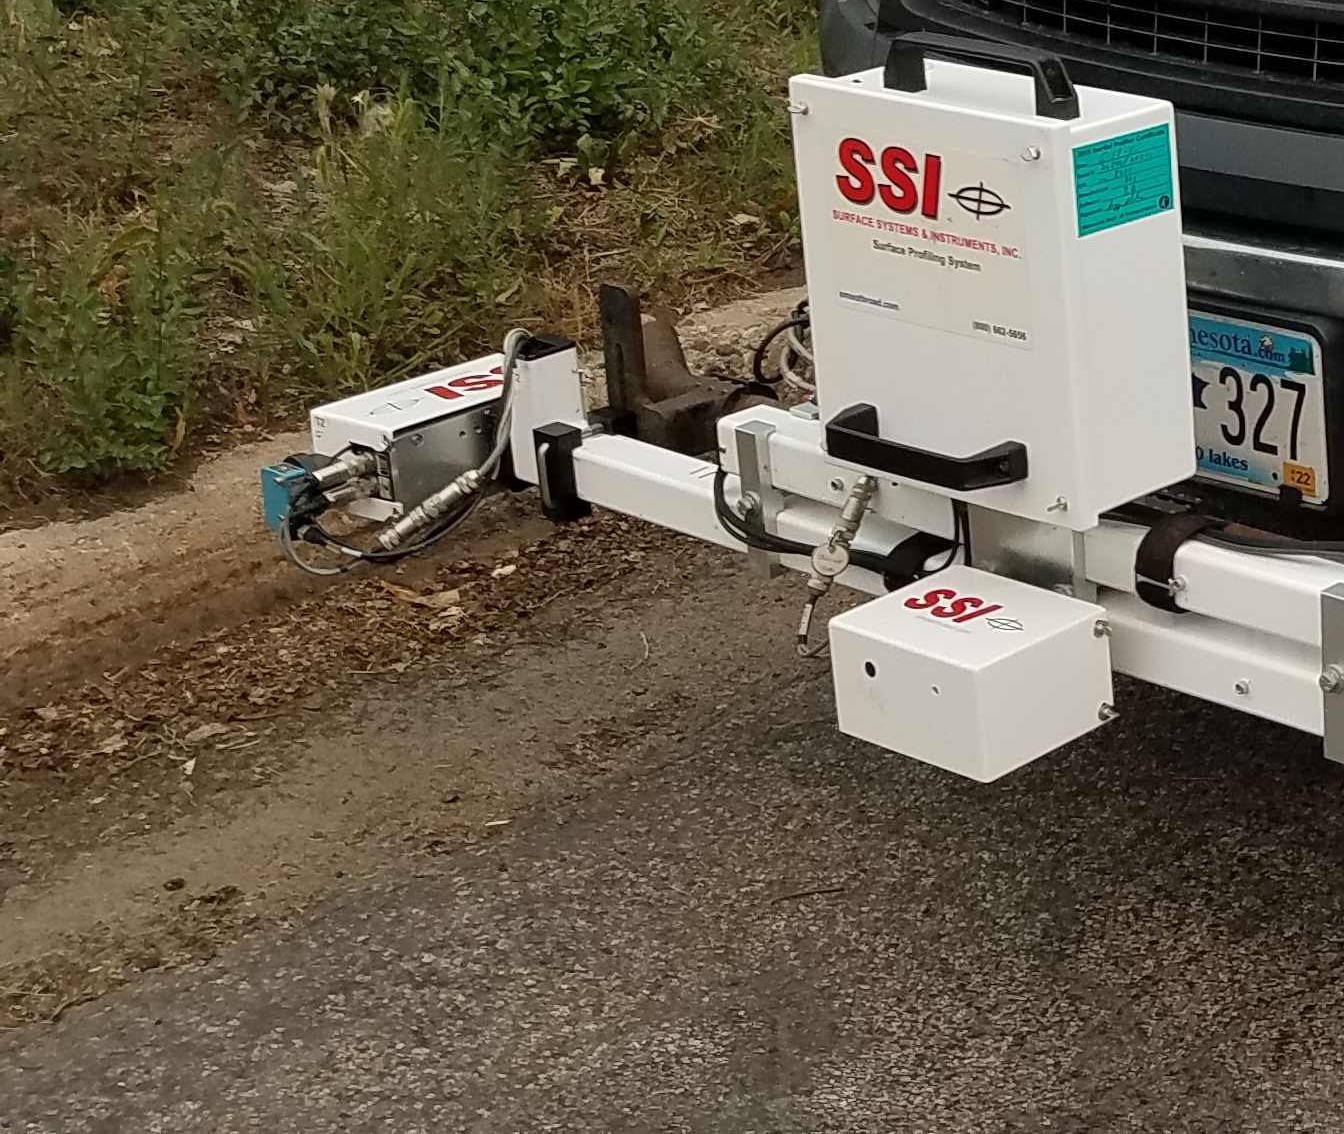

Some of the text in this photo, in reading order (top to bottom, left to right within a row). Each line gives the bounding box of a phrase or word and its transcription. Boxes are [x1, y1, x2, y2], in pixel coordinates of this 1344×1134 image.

[836, 137, 941, 221] SSI
[832, 209, 874, 228] SURFACE
[877, 219, 919, 237] SYSTEMS
[922, 228, 928, 239] &
[1002, 246, 1021, 259] INC.
[873, 239, 981, 272] Surface Profiling System
[1218, 366, 1306, 461] 327
[1209, 449, 1249, 471] lakes
[904, 589, 1003, 623] SSI
